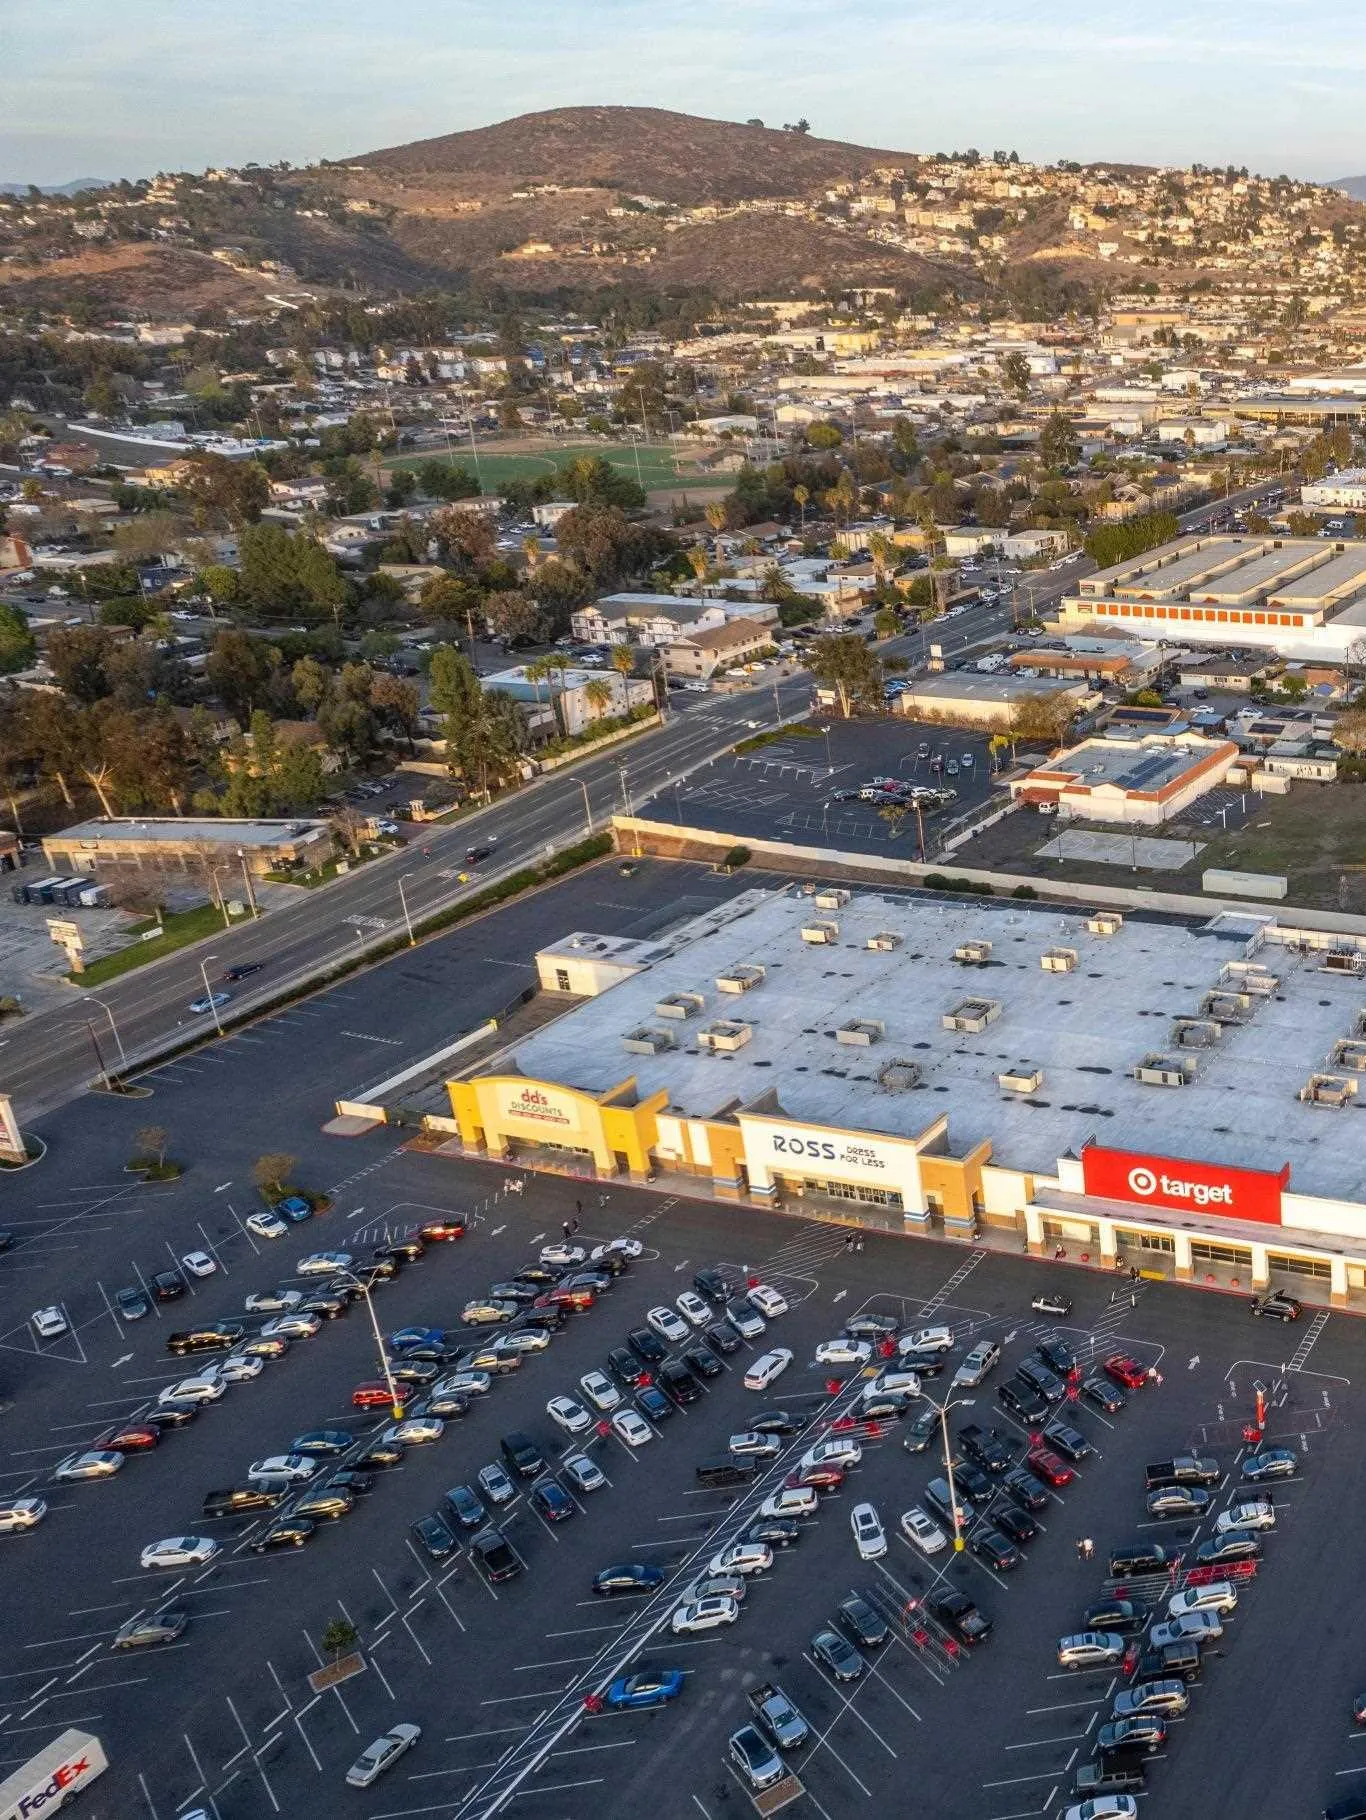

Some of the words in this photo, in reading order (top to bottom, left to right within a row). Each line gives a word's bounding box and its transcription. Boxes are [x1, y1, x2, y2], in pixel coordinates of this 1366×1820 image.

[511, 1101, 562, 1116] DISCOUNTS
[773, 1135, 835, 1160] ROSS
[846, 1146, 876, 1157] DRESS
[840, 1153, 859, 1164] FOR
[861, 1157, 885, 1168] LESS
[1160, 1175, 1233, 1205] target
[17, 1756, 91, 1819] FedEx
